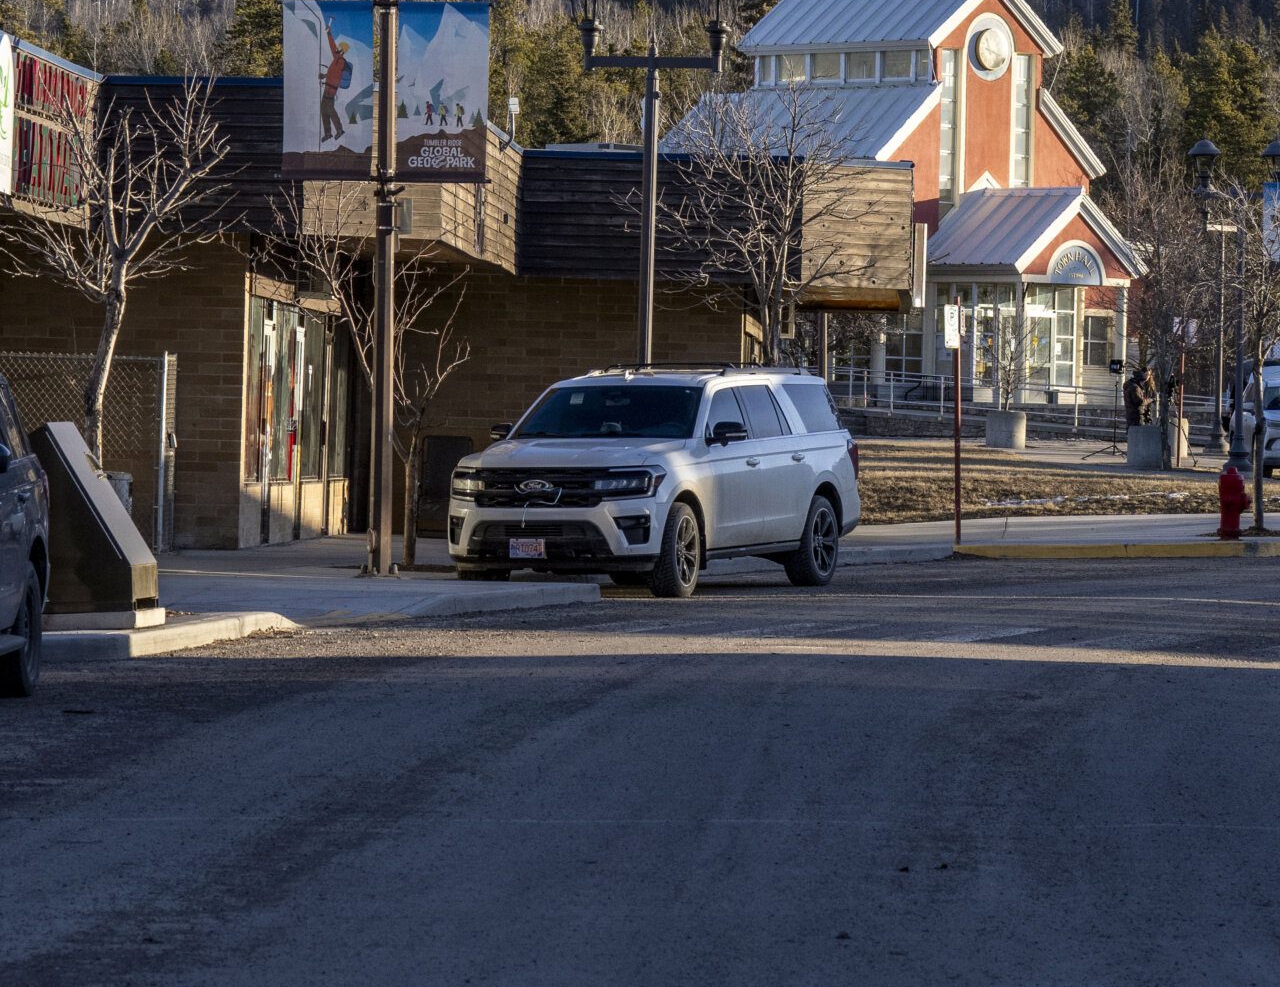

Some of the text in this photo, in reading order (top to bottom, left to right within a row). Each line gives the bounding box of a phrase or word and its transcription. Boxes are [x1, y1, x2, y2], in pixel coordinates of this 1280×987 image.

[421, 147, 464, 157] GLOBAL
[1054, 251, 1096, 276] TOWN HALL
